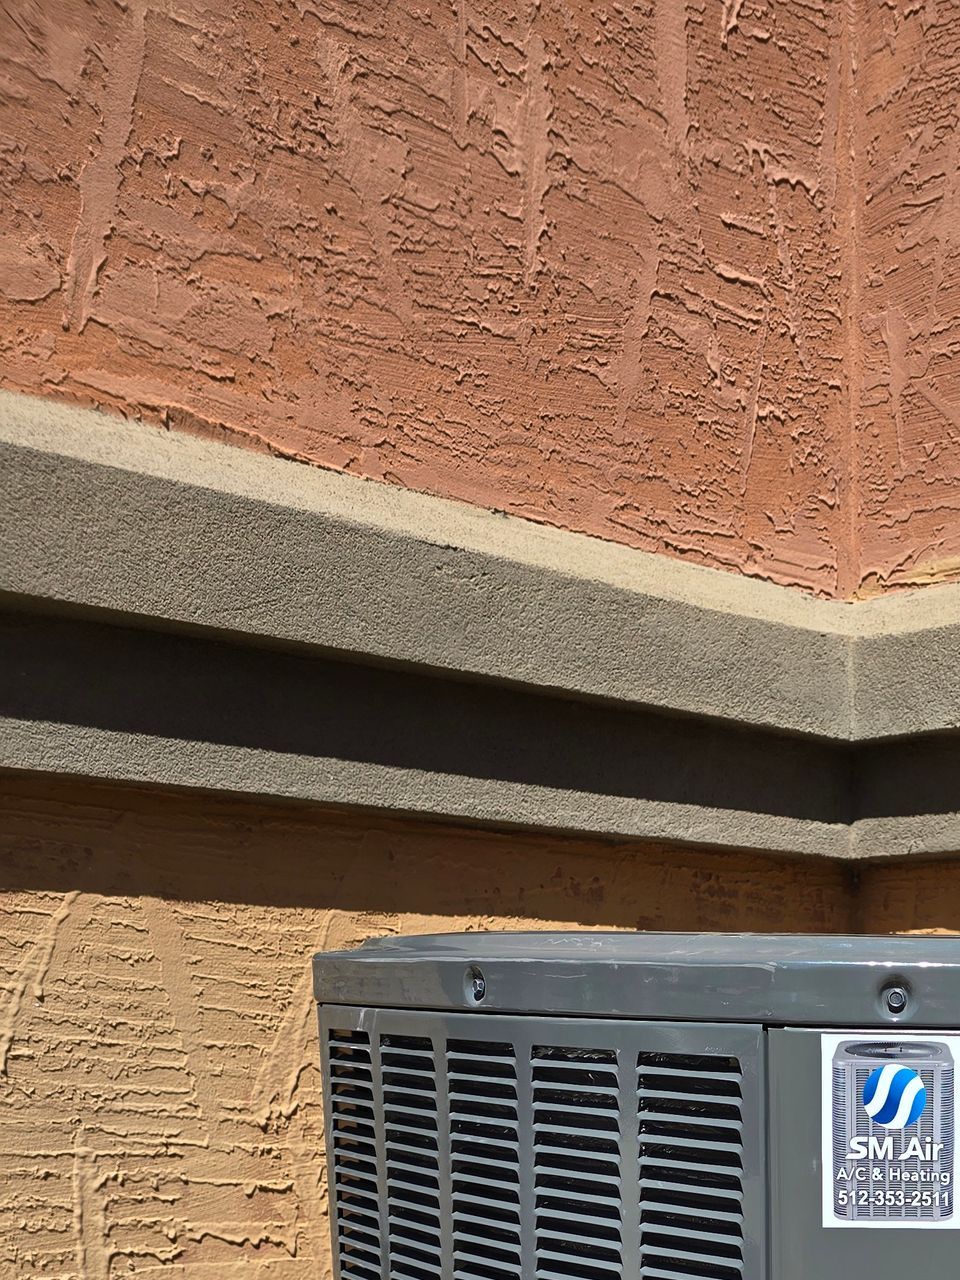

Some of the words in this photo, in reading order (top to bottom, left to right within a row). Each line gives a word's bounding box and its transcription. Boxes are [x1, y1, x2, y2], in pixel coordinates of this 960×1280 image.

[845, 1136, 893, 1160] SM
[898, 1136, 944, 1160] Air
[836, 1167, 868, 1181] A/C
[872, 1168, 884, 1181] &
[889, 1168, 951, 1185] Heating
[838, 1190, 949, 1207] 512-353-2511
